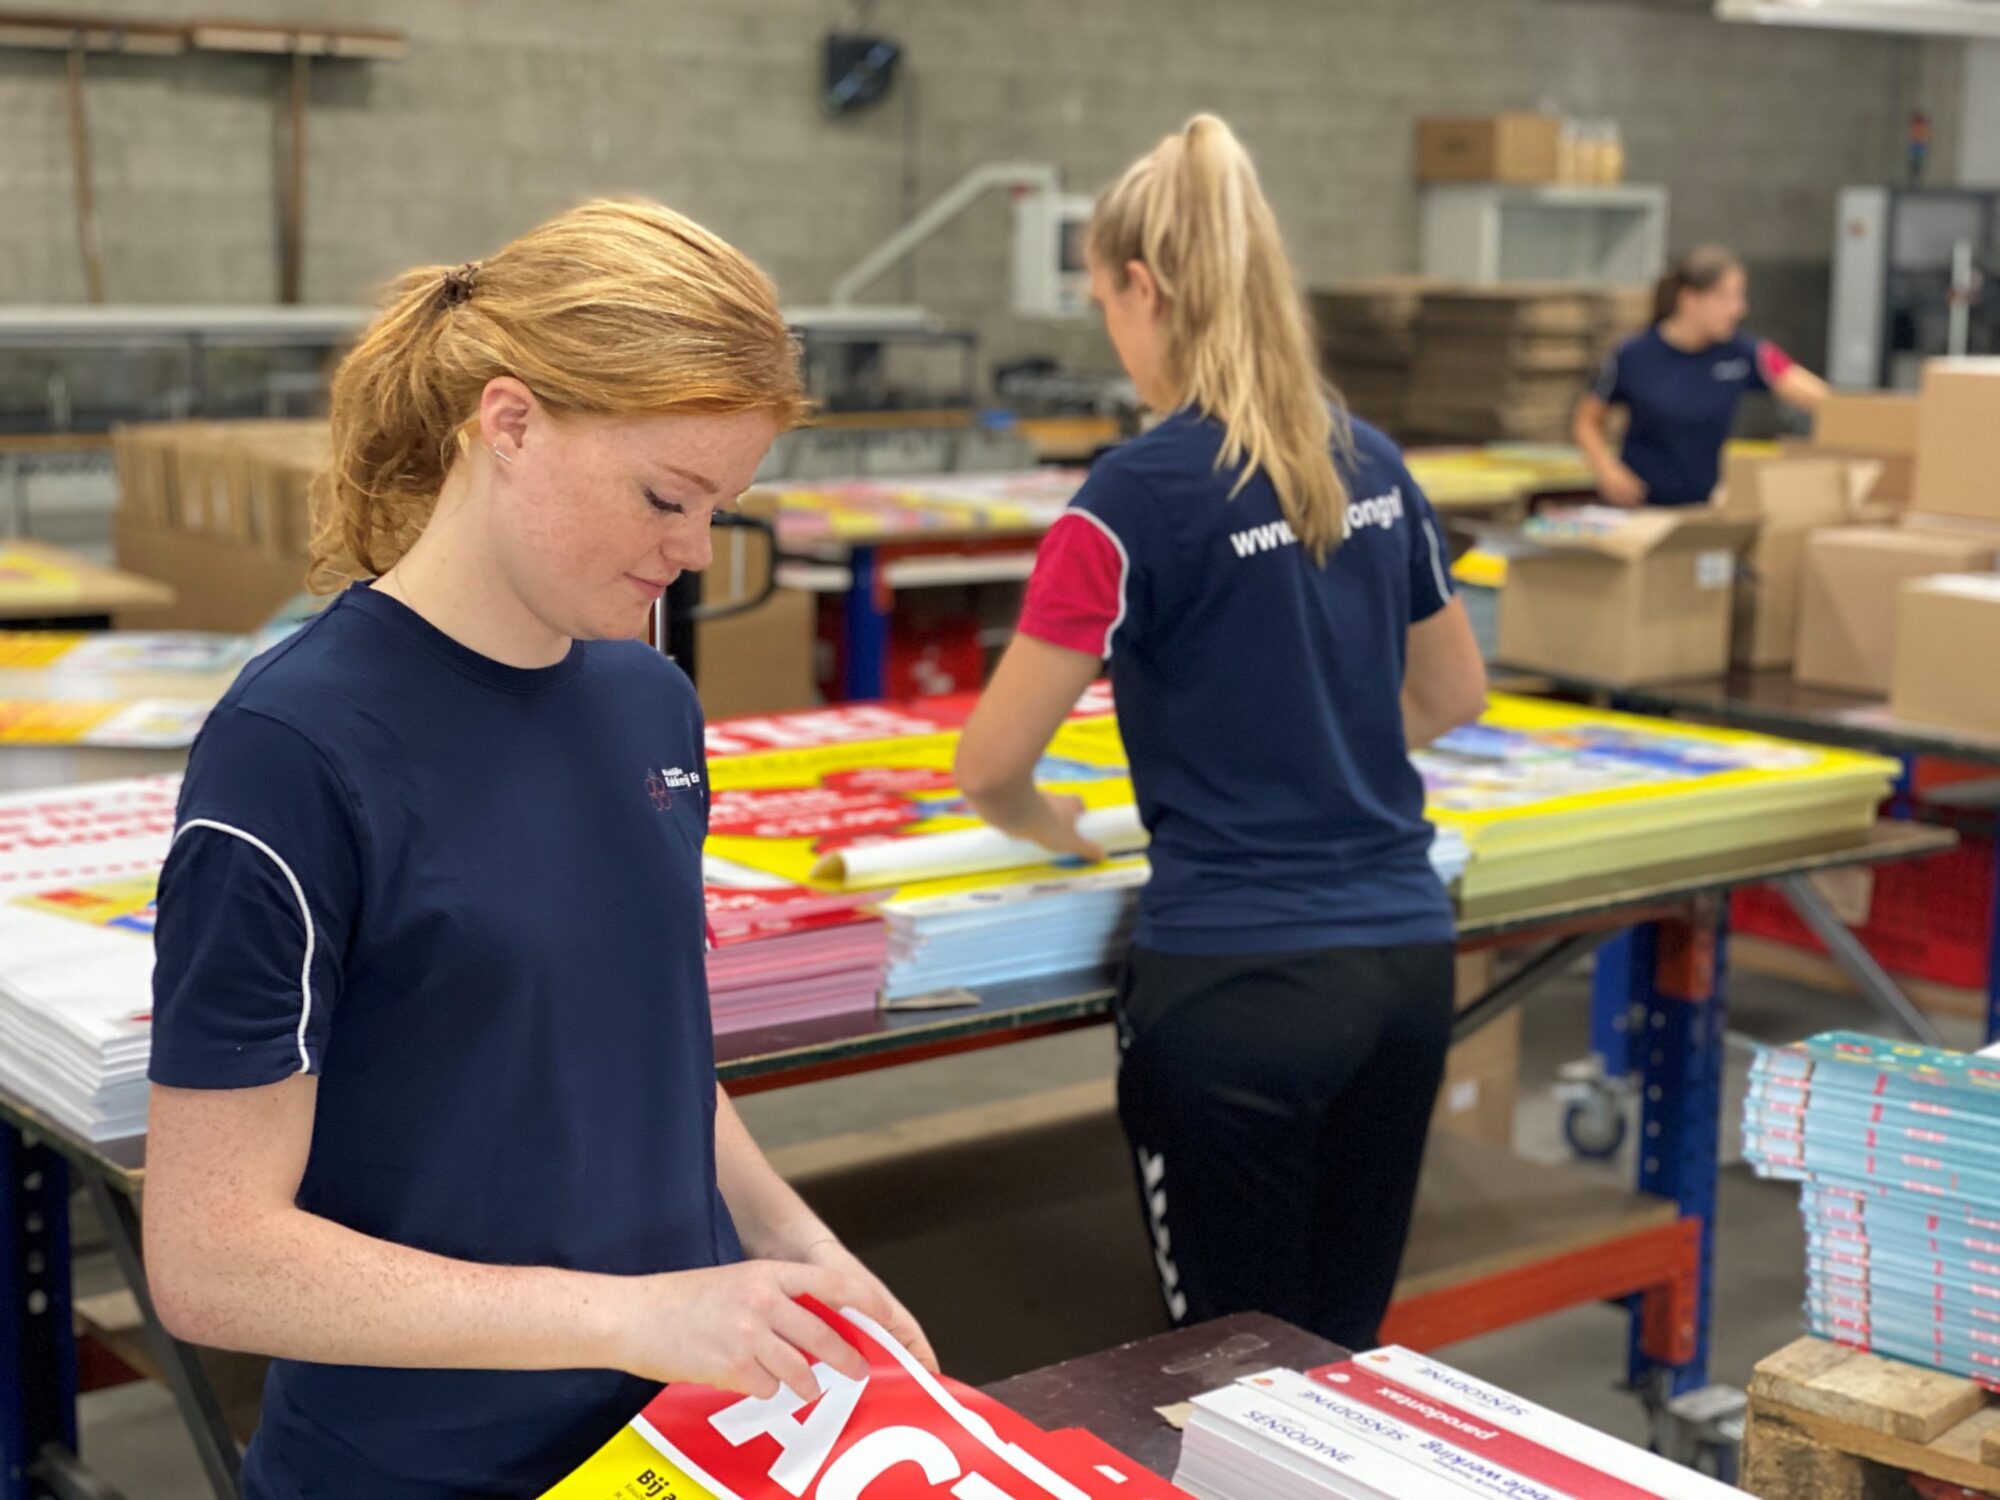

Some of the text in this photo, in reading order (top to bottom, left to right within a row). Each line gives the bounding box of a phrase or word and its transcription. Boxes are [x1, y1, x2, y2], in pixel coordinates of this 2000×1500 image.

[1298, 1390, 1410, 1442] SENSODYNE
[1375, 1386, 1500, 1441] parodontax
[1416, 1366, 1530, 1417] SENSODYNE
[1244, 1410, 1355, 1464] SENSODYNE
[1420, 1440, 1502, 1481] werking
[636, 1468, 670, 1498] Bij
